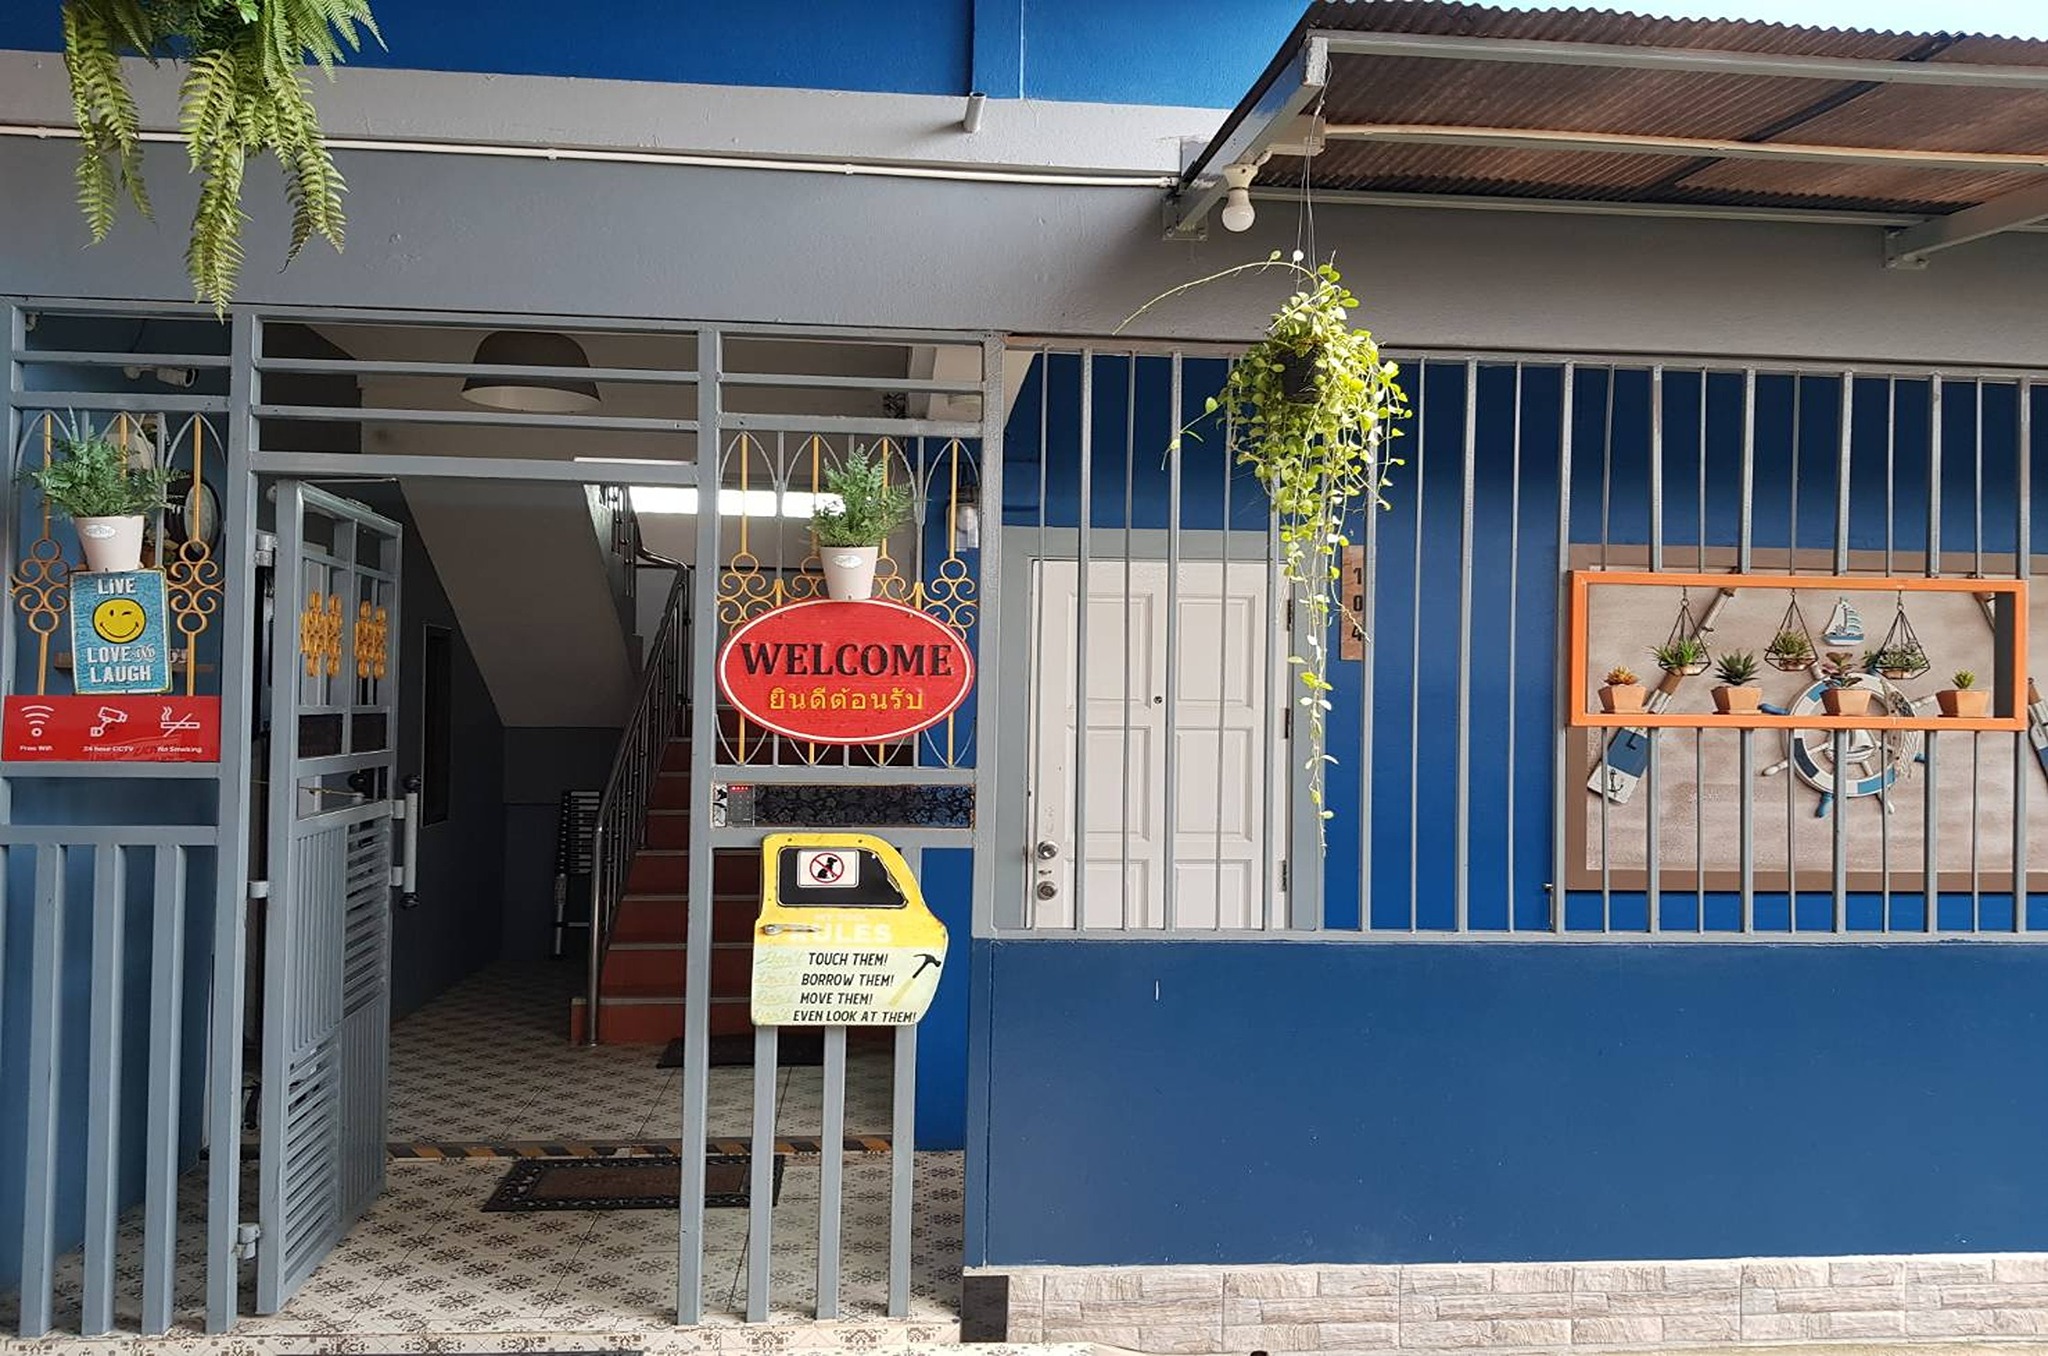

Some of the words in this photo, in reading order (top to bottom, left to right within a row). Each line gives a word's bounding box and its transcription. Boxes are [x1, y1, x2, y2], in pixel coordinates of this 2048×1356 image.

[86, 646, 131, 664] LOVE
[741, 642, 953, 677] WELCOME
[89, 665, 152, 683] LAUGH
[769, 686, 924, 710] ยินดีต้อนรับ
[169, 746, 203, 754] Smoking
[808, 952, 848, 966] TOUCH
[852, 953, 889, 966] THEM!
[801, 973, 855, 987] BORROW
[859, 974, 895, 987] THEM!
[799, 992, 833, 1005] MOVE
[837, 993, 873, 1005] THEM!
[793, 1010, 824, 1022] EVEN
[826, 1011, 856, 1022] LOOK
[860, 1011, 877, 1022] AT
[881, 1011, 918, 1023] THEM!
